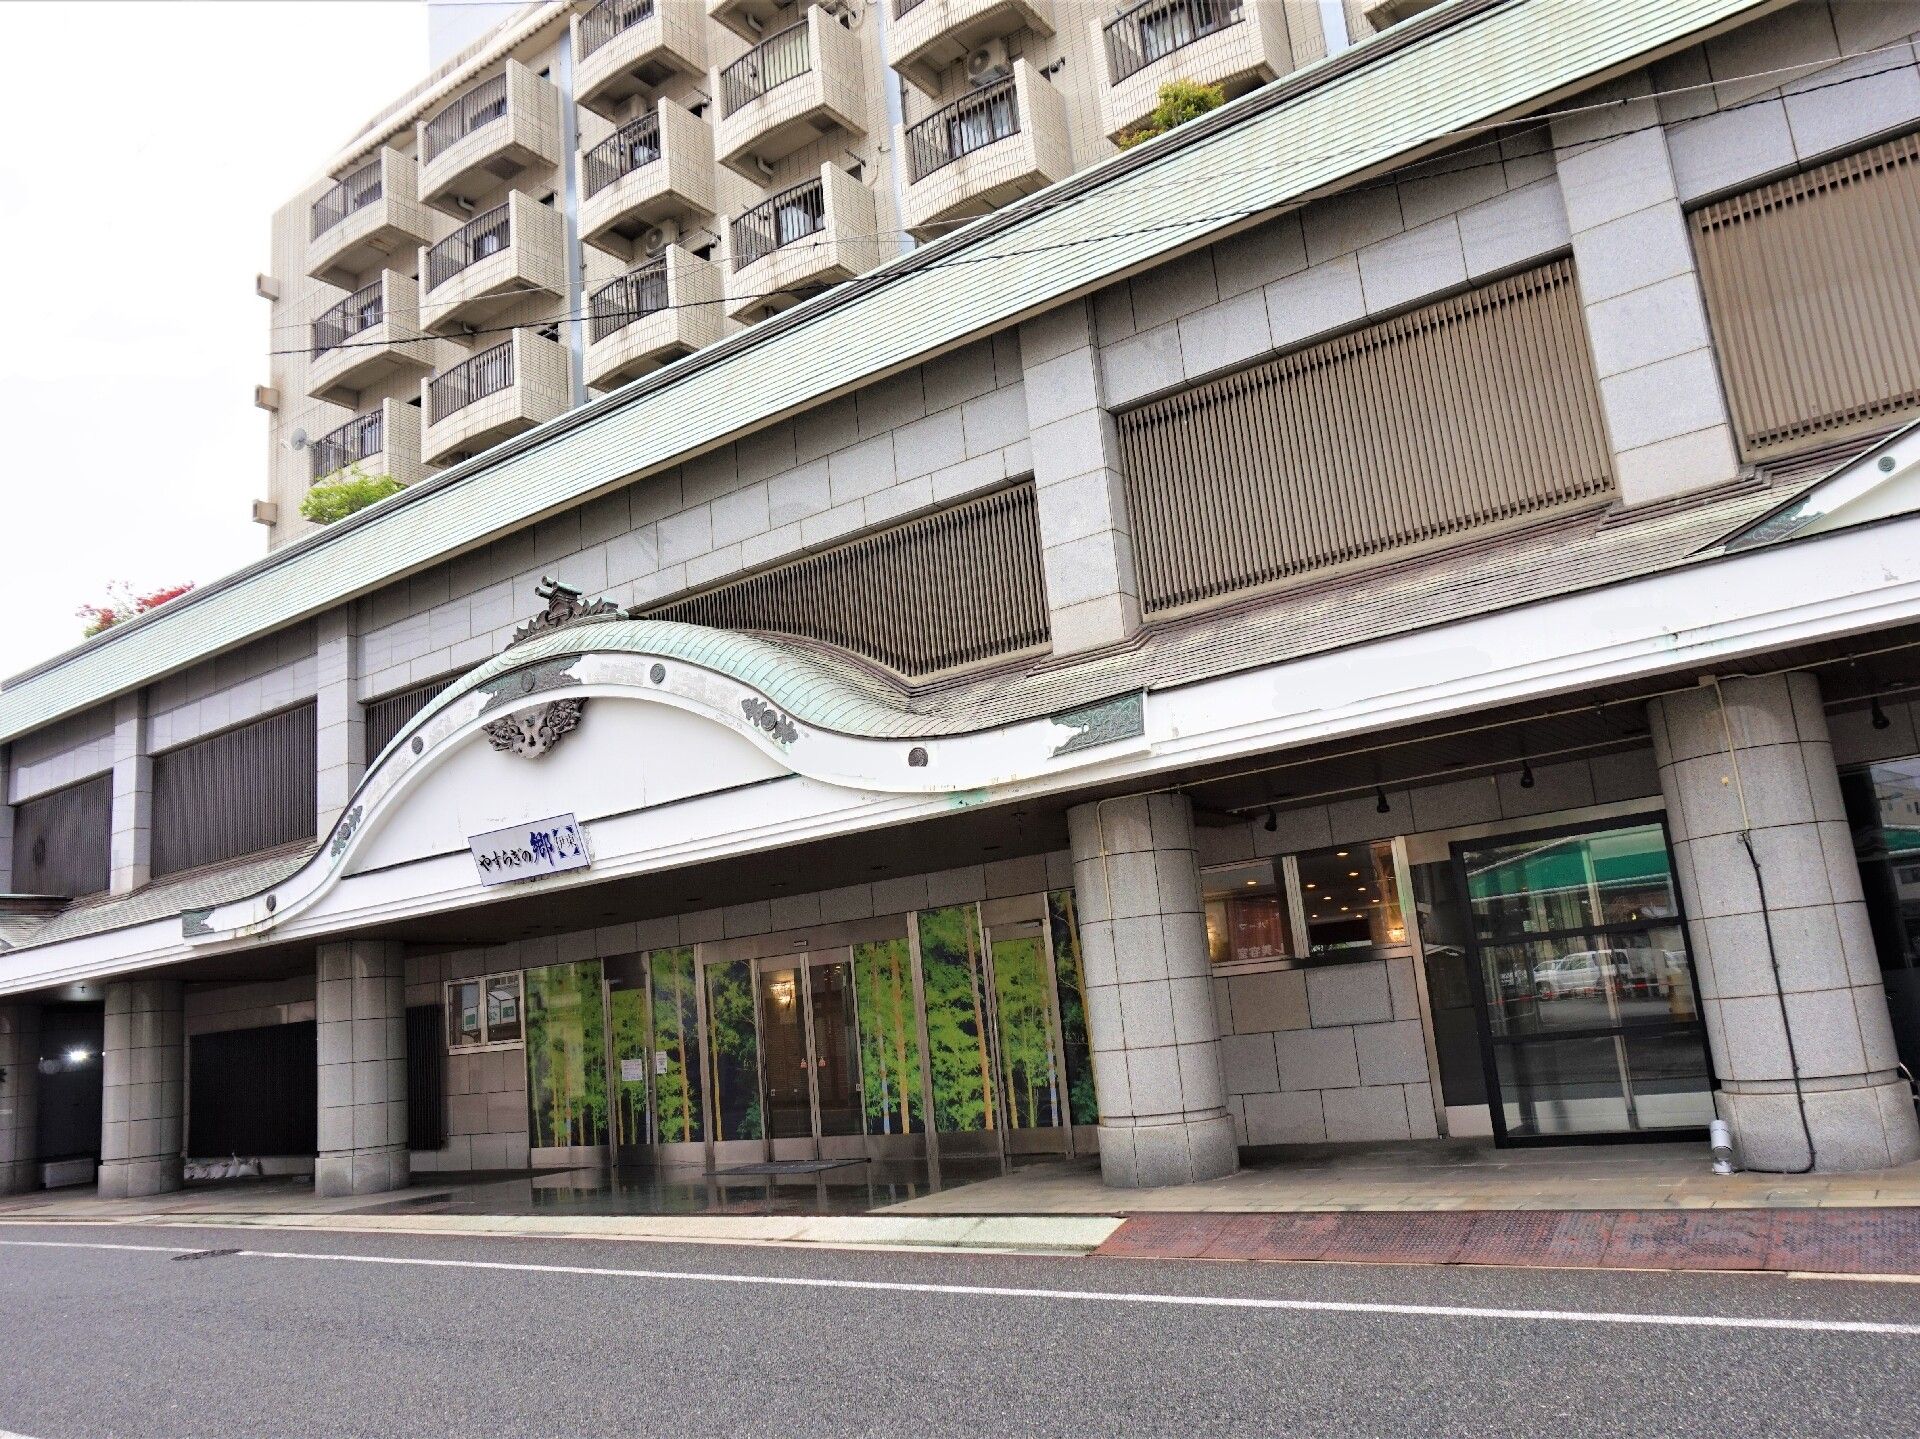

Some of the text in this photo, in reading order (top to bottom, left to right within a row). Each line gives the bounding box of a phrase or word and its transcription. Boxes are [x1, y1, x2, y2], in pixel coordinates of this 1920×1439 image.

[479, 831, 555, 871] やすらぎの郷
